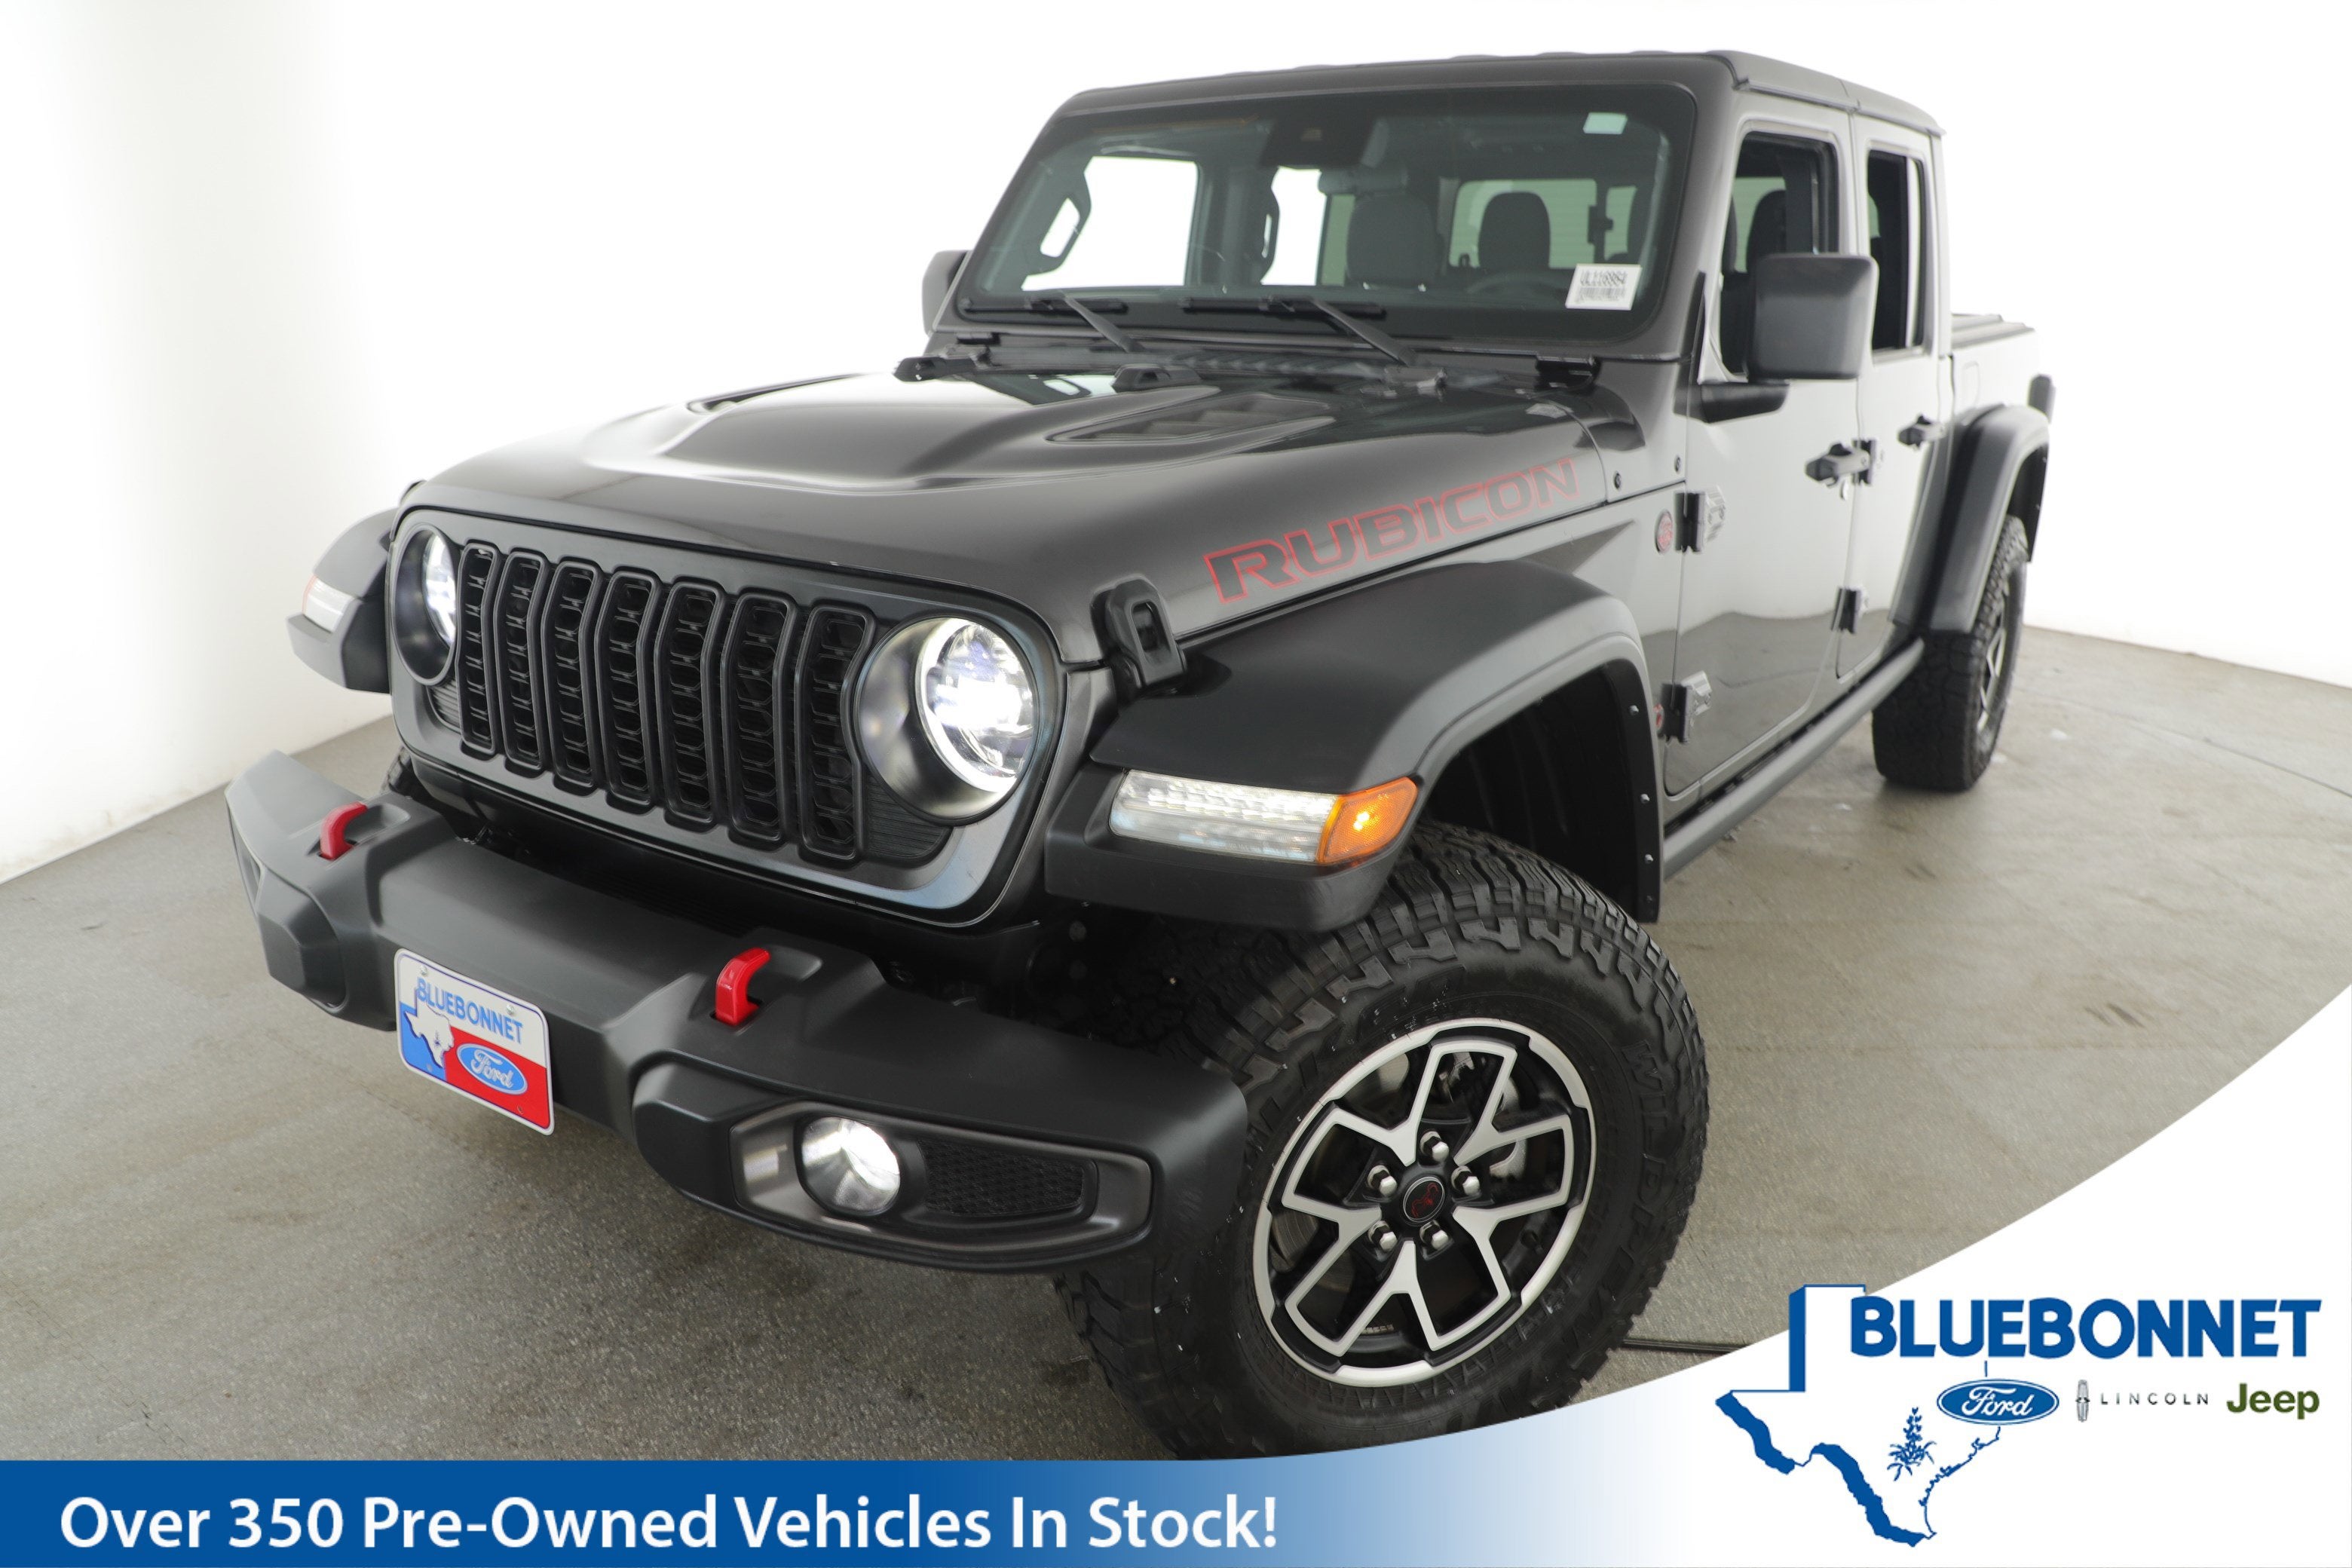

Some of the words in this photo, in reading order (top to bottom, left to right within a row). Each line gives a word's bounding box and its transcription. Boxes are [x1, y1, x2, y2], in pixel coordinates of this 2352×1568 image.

[1202, 458, 1580, 604] RUBICON
[417, 978, 523, 1044] BLUEBONNET
[470, 1049, 514, 1089] Ford
